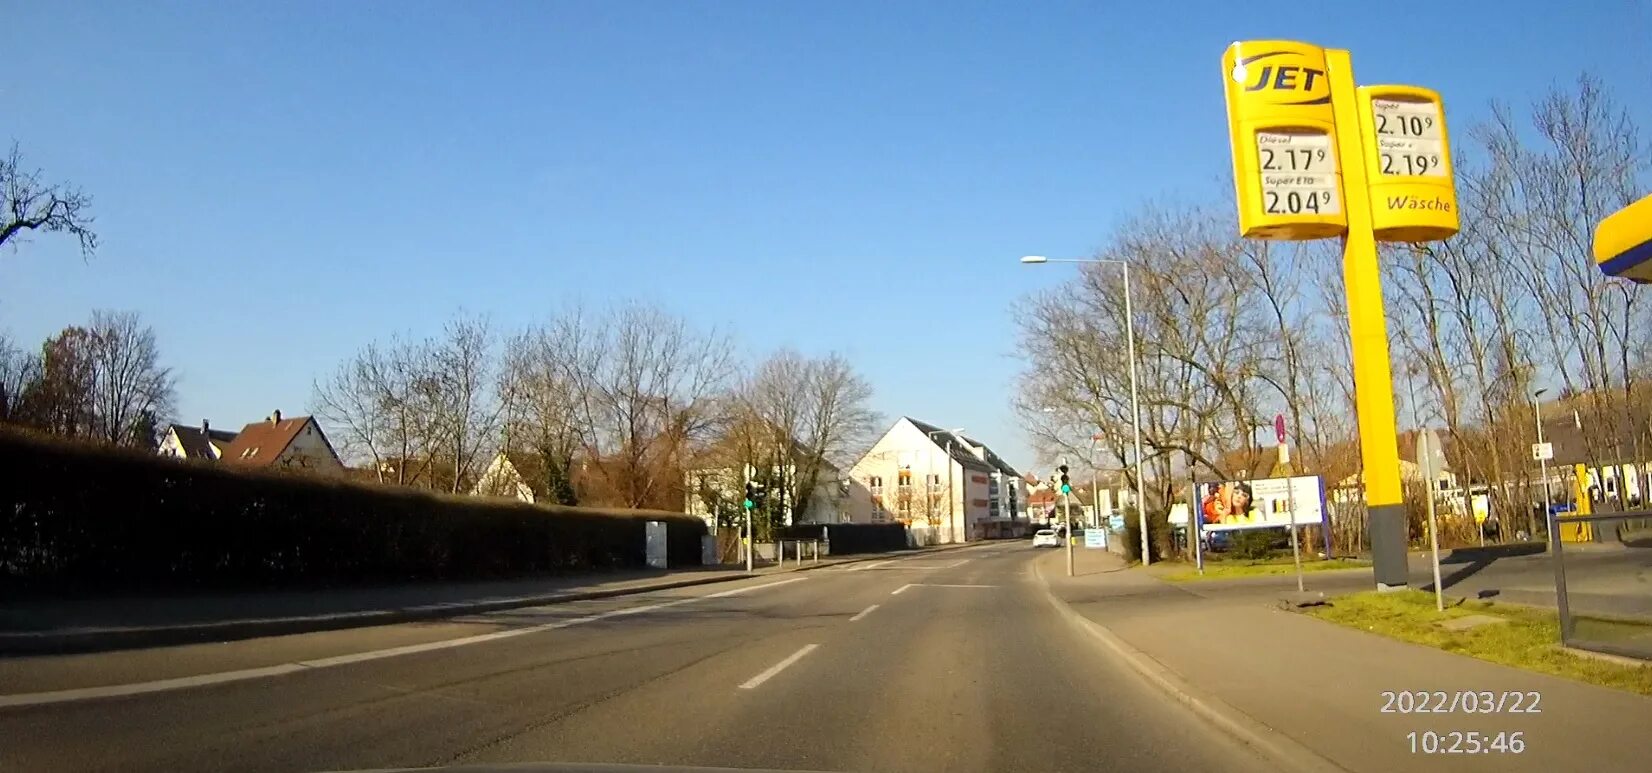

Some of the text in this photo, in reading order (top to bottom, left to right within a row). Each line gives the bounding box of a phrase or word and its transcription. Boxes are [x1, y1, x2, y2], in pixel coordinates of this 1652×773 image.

[1245, 66, 1323, 92] JET
[1259, 135, 1291, 144] Diesel
[1265, 176, 1294, 188] Super
[1387, 194, 1451, 213] Wäsche
